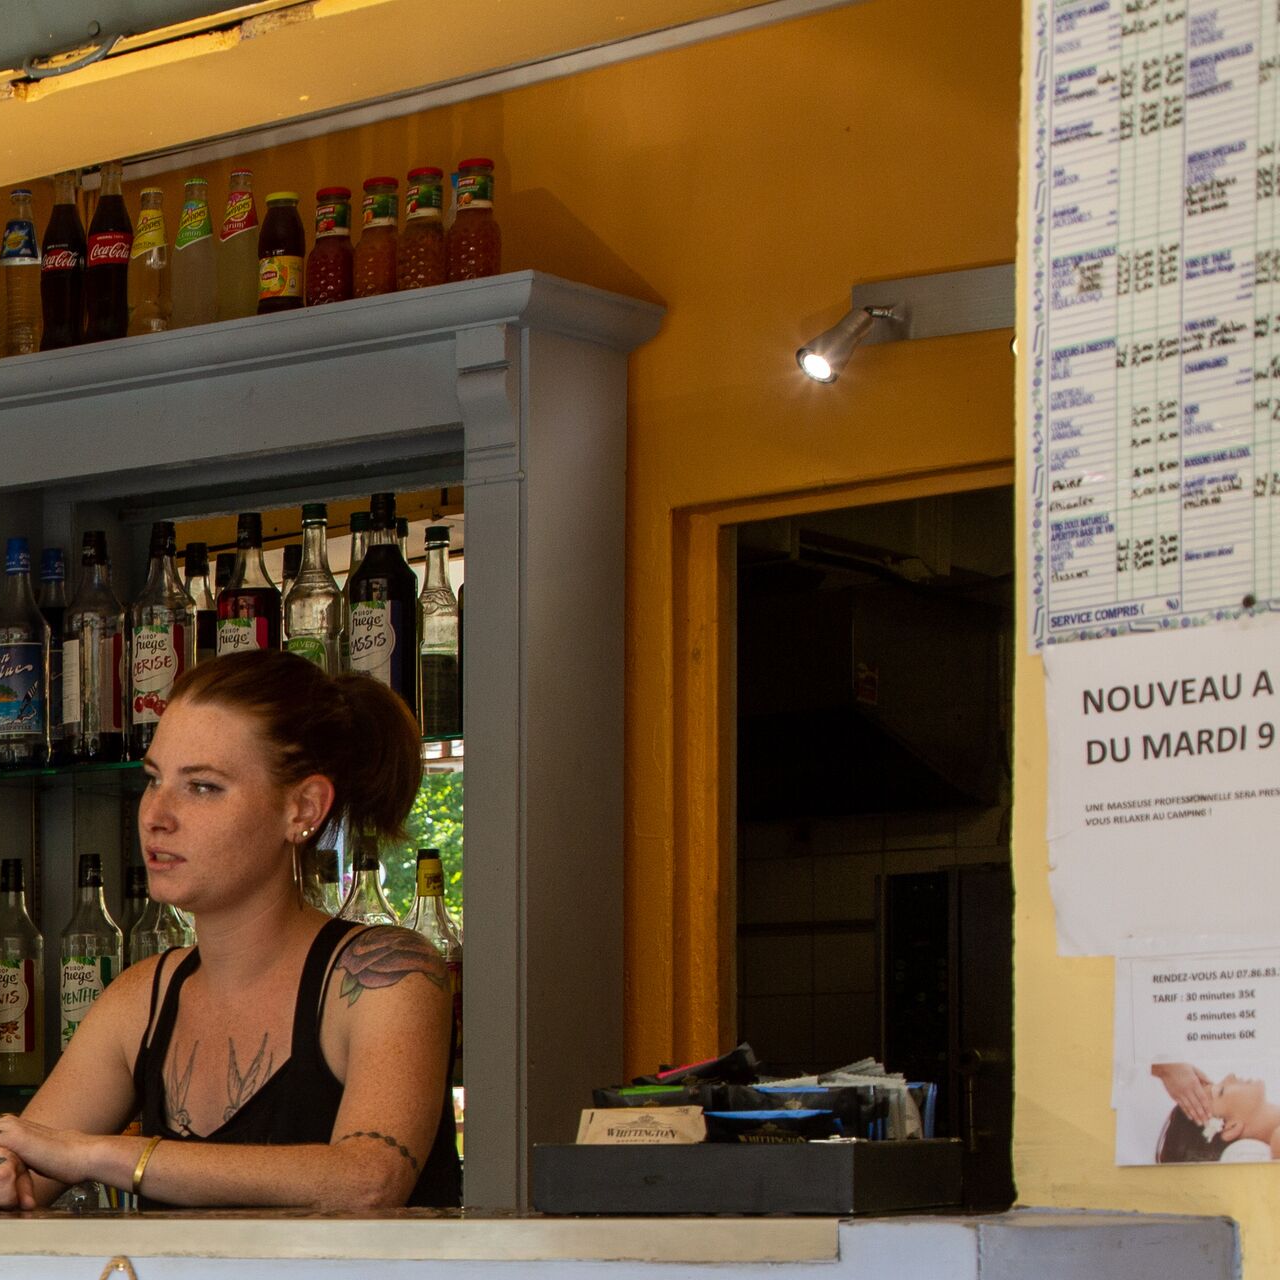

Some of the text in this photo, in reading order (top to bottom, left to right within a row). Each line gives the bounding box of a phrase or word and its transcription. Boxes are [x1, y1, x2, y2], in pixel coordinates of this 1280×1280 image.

[42, 250, 79, 271] Coca-Cola
[90, 242, 130, 261] Coca-Cola
[1051, 603, 1139, 628] SERVICE COMPRIS
[1083, 669, 1274, 715] NOUVEAU A
[1086, 722, 1275, 765] DU MARDI 9
[1085, 801, 1105, 813] UNE
[1107, 797, 1153, 812] MASSEUSE
[1154, 791, 1232, 807] PROFESSIONNELLE
[1234, 789, 1257, 800] SERA
[1085, 814, 1111, 827] VOUS
[1113, 812, 1151, 825] RELAXER
[1153, 811, 1165, 821] AU
[1167, 808, 1207, 820] CAMPING
[1152, 971, 1218, 984] RENDEZ-VOUS
[1220, 970, 1235, 980] AU
[1152, 988, 1256, 1004] TARIF 30 minutes 35€
[1186, 1008, 1256, 1022] 45 minutes 45€
[1186, 1029, 1256, 1042] 60 minutes 60€
[607, 1127, 678, 1139] WHITTINGTON
